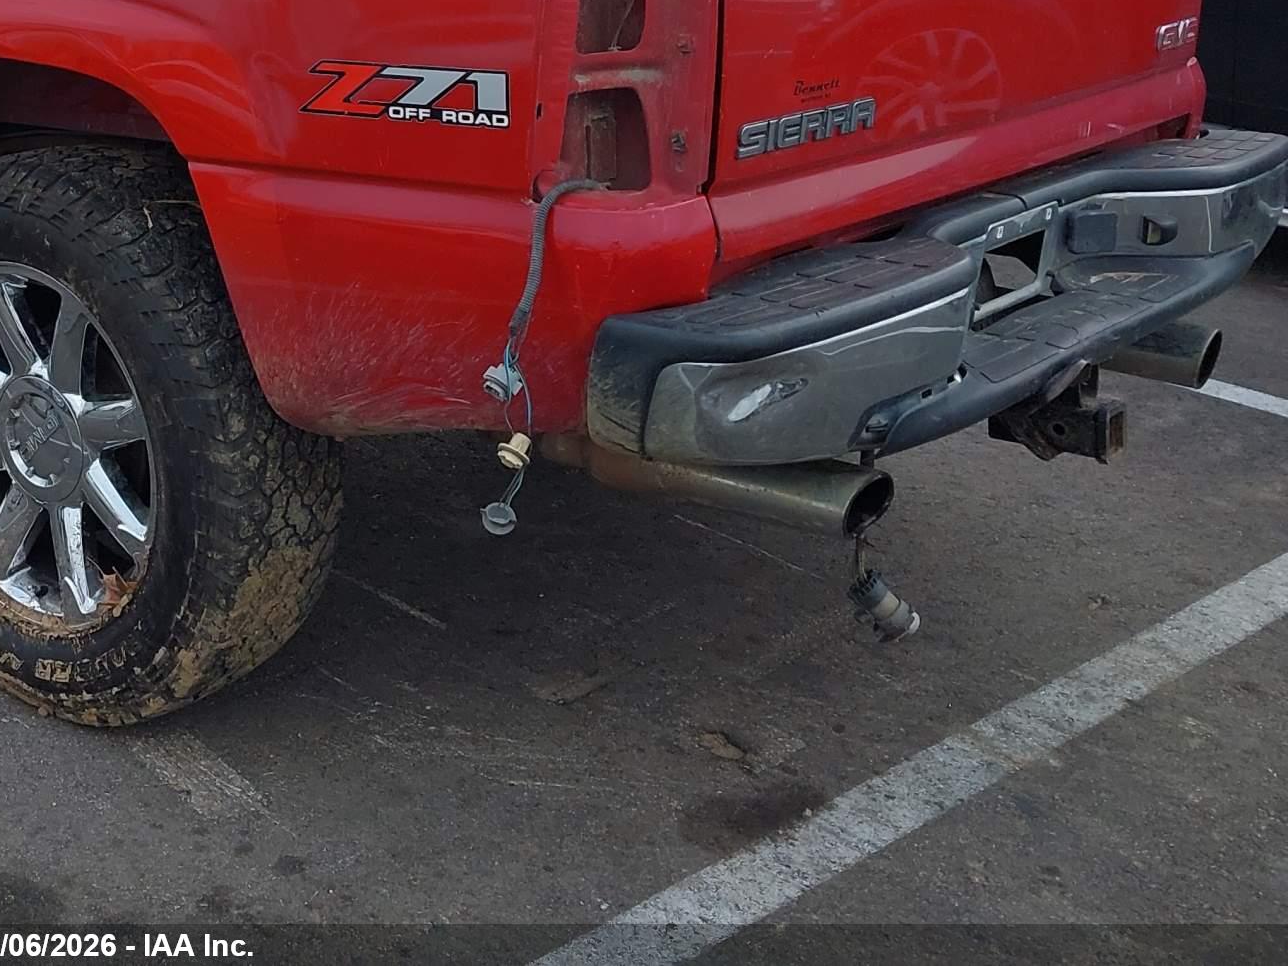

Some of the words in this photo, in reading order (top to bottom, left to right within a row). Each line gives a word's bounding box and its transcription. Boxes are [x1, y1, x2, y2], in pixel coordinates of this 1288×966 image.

[298, 60, 509, 119] Z71
[793, 79, 840, 96] Bennett
[387, 106, 430, 122] OFF
[441, 111, 509, 128] ROAD
[737, 97, 875, 160] SIERRA
